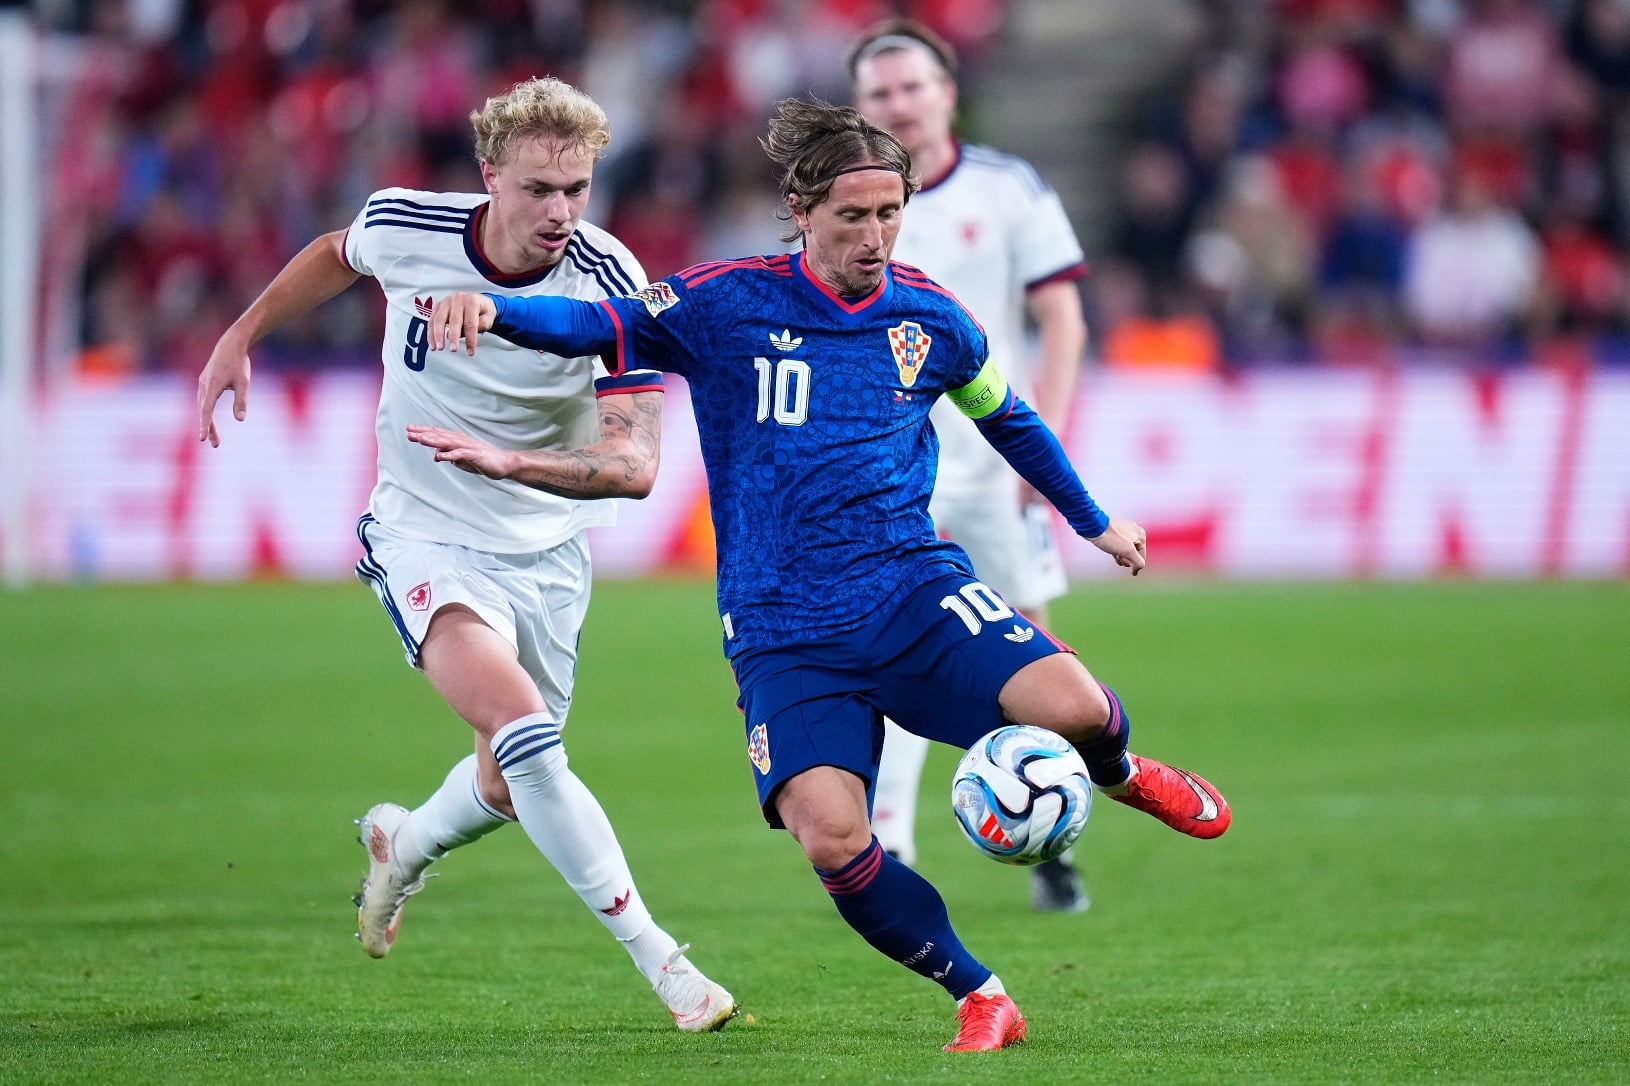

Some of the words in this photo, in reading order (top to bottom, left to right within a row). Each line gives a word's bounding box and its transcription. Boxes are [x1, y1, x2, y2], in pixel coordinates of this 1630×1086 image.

[404, 316, 430, 372] 9
[906, 330, 915, 360] HNS
[754, 357, 812, 426] 10
[940, 582, 1014, 636] 10
